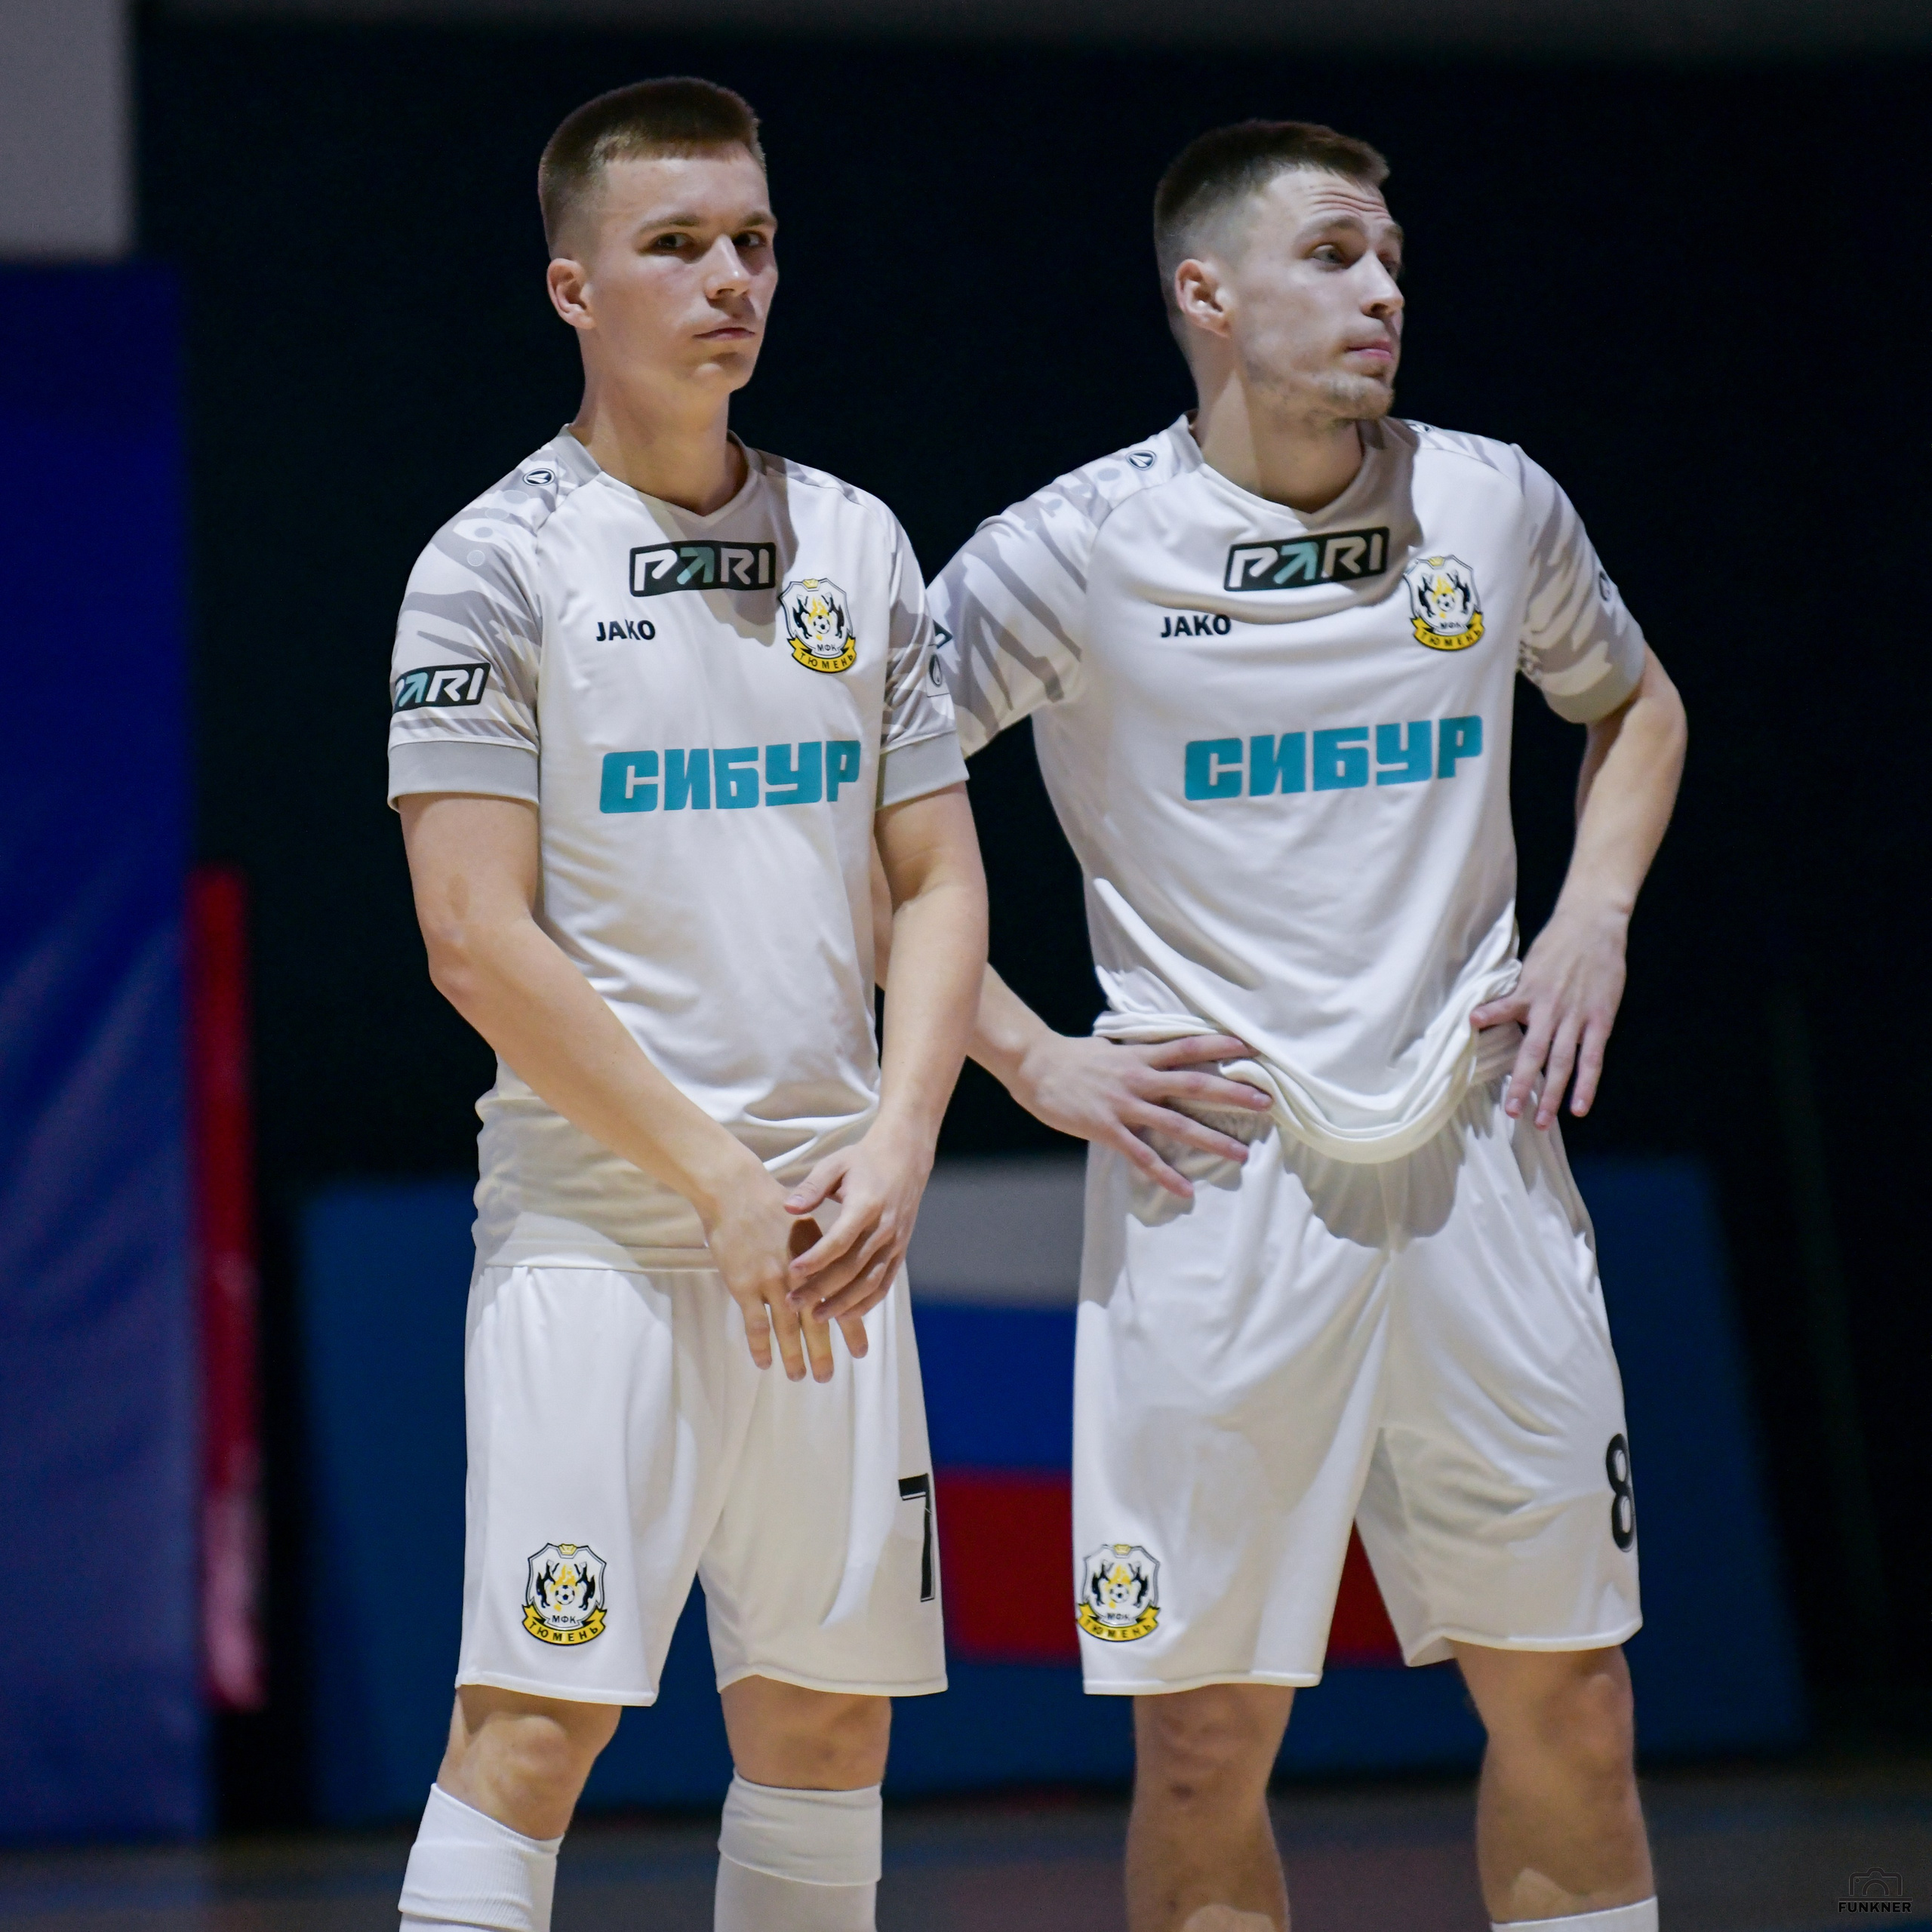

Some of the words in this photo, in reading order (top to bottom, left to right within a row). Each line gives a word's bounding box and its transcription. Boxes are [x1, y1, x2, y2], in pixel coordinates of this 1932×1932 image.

[633, 546, 770, 591] PARI
[1228, 533, 1383, 588] PARI
[596, 619, 656, 641] JAKO
[1160, 614, 1232, 638] JAKO
[799, 653, 854, 669] ТЮМЕНЬ
[599, 740, 861, 814] СИБУР
[1184, 715, 1483, 801] СИБУР
[1605, 1433, 1635, 1552] 8
[898, 1473, 935, 1602] 7
[529, 1620, 598, 1641] ТЮМЕНЬ
[552, 1615, 576, 1623] МФК
